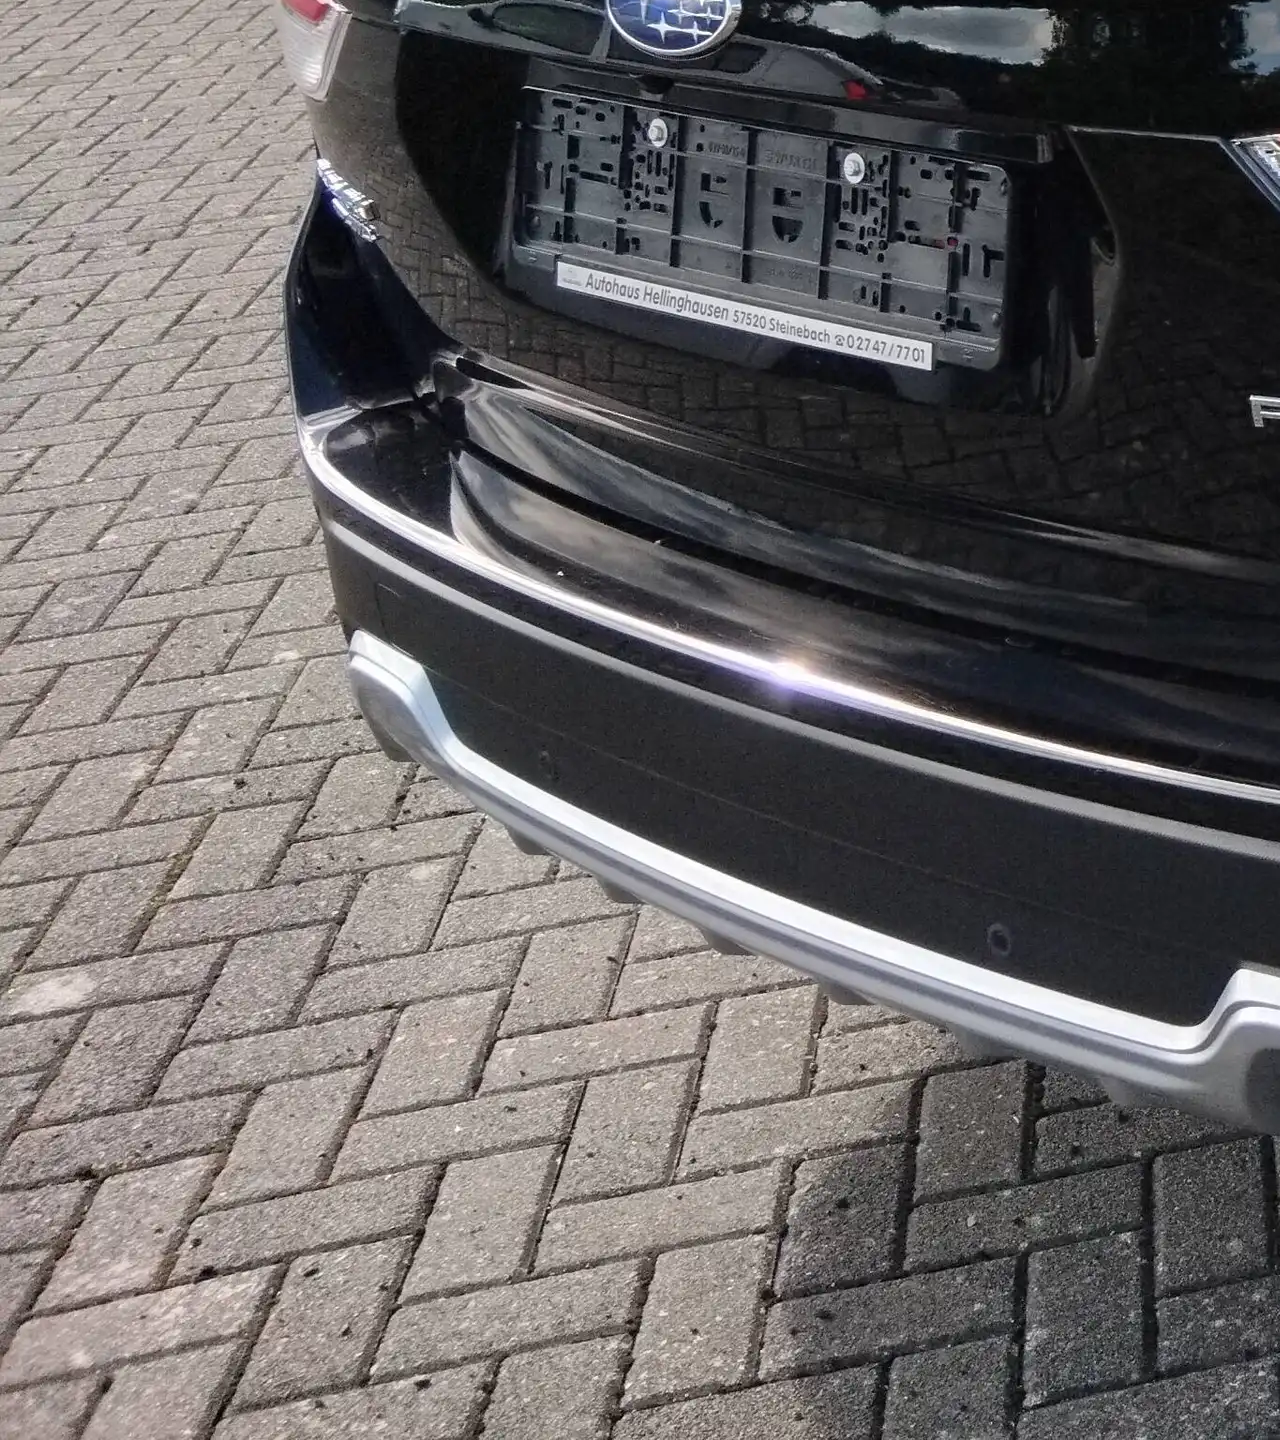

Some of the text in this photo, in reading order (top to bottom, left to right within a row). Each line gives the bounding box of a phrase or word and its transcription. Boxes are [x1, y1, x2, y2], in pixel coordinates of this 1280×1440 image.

[585, 273, 640, 300] Autohaus
[643, 285, 729, 320] Hellinghausen
[733, 309, 767, 329] 57520
[769, 319, 830, 344] Steinebach
